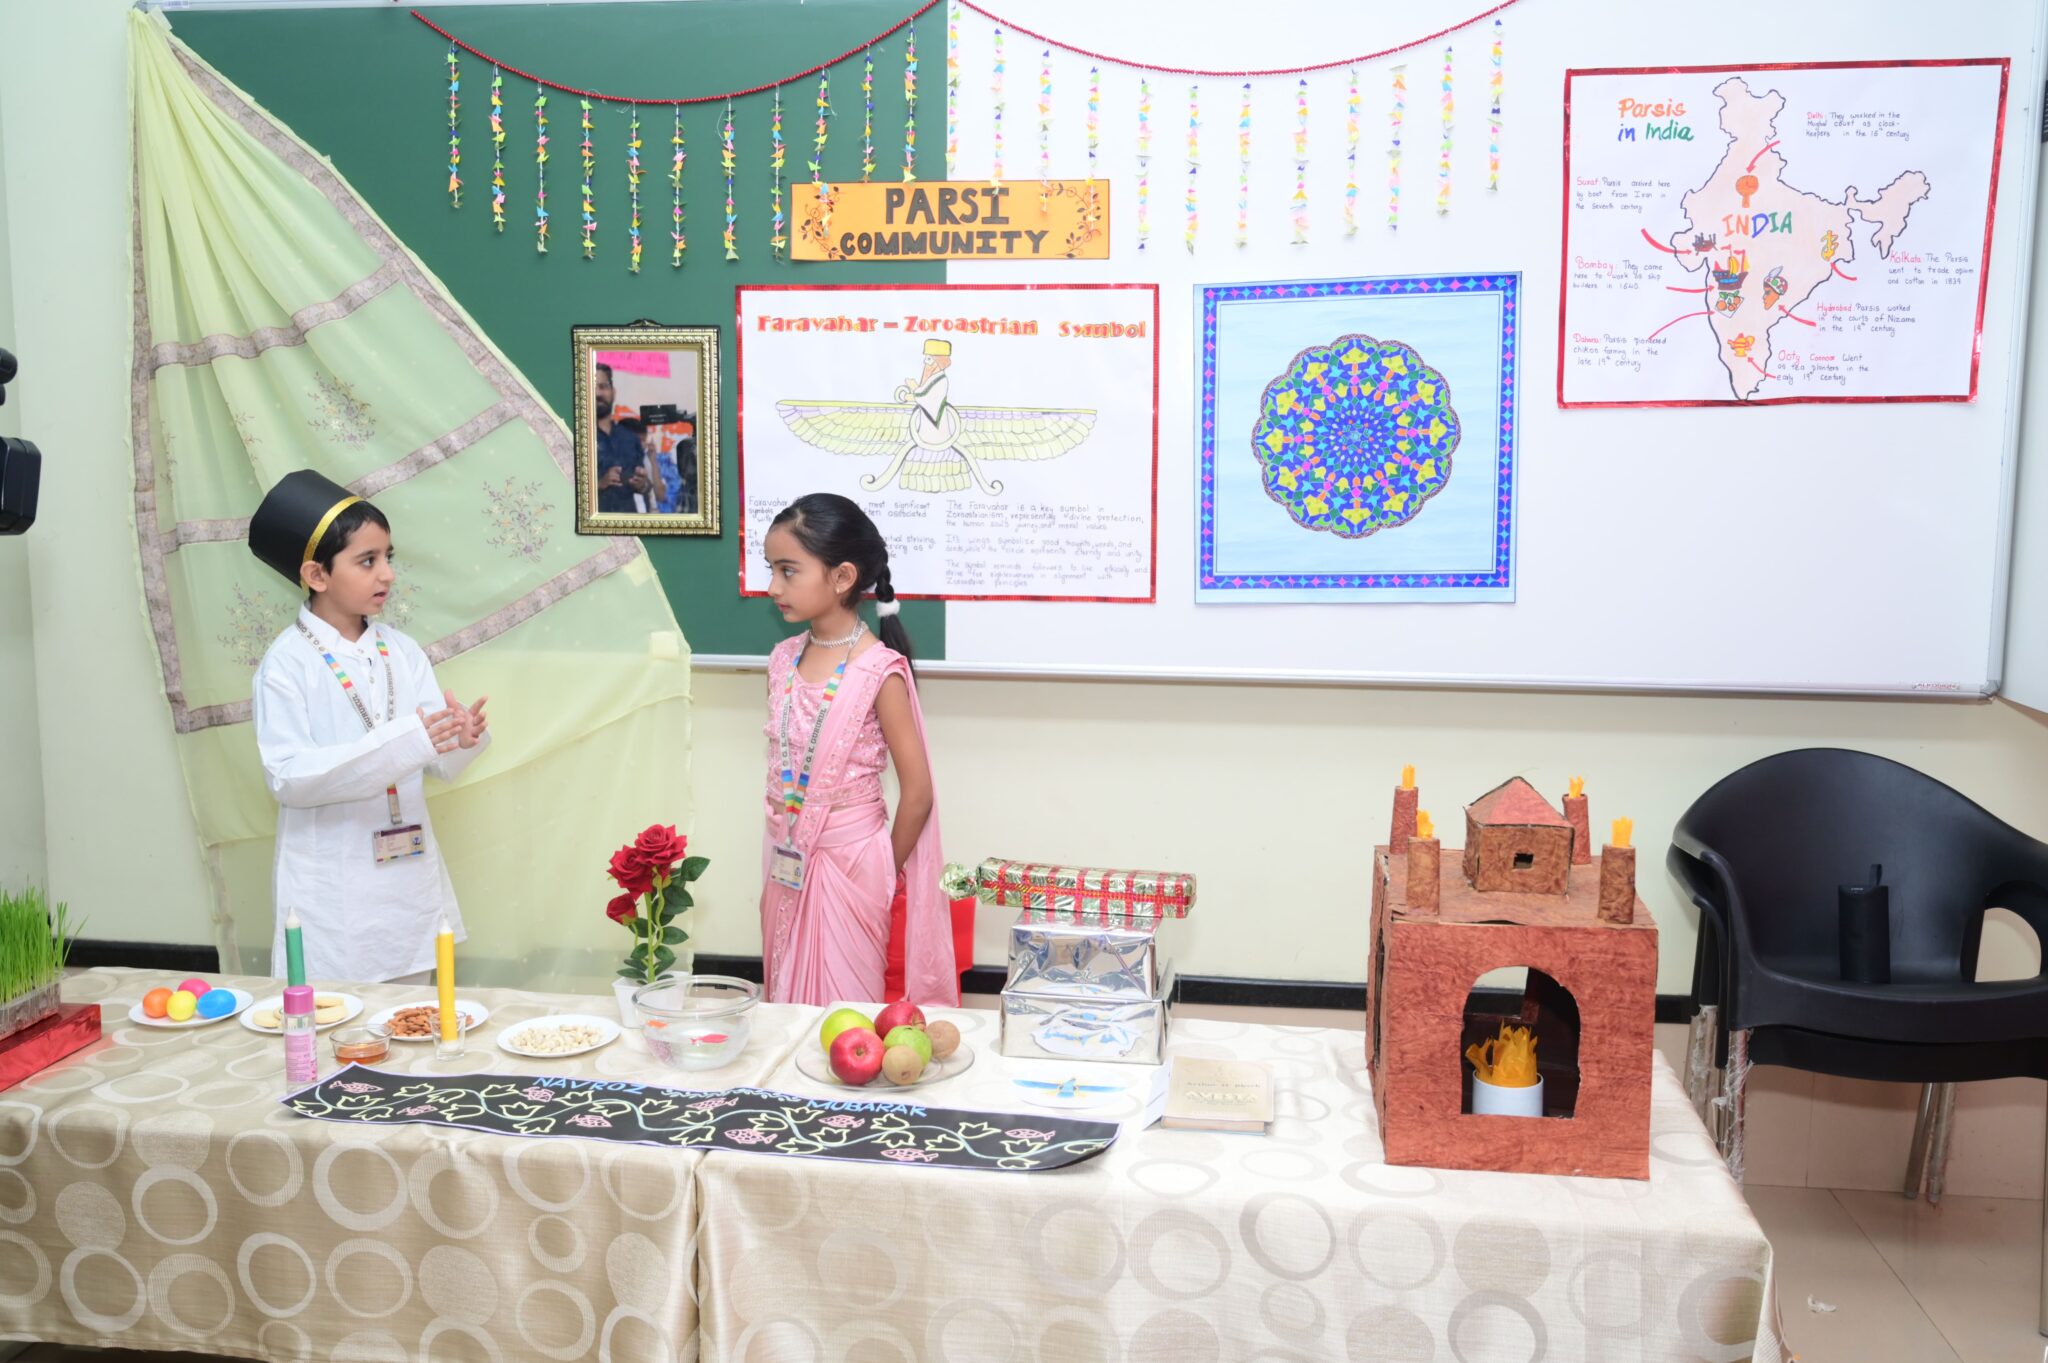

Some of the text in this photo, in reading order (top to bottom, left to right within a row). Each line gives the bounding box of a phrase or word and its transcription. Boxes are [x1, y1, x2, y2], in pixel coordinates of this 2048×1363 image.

[1617, 97, 1687, 118] Parsis
[1829, 111, 1845, 122] They
[1850, 111, 1876, 119] worked
[1888, 111, 1901, 119] the
[1833, 120, 1854, 128] court
[1617, 119, 1695, 142] in India
[1855, 129, 1867, 137] the
[1886, 129, 1910, 142] century
[1658, 179, 1671, 188] here
[1576, 190, 1584, 201] by
[1588, 190, 1602, 198] boat
[1611, 189, 1628, 198] from
[1634, 190, 1652, 198] Iran
[885, 187, 1010, 225] PARSI
[1576, 202, 1585, 210] the
[1620, 203, 1643, 214] century
[1722, 211, 1793, 240] INDIA
[839, 230, 1050, 256] COMMUNITY
[1925, 252, 1941, 263] The
[1944, 251, 1969, 263] Parsis
[1595, 272, 1603, 280] to
[1888, 266, 1904, 274] went
[1914, 266, 1922, 274] to
[1928, 266, 1949, 274] trade
[1888, 277, 1899, 285] and
[1855, 302, 1880, 312] Parsis
[1886, 304, 1912, 312] worked
[1818, 314, 1826, 322] in
[1832, 314, 1843, 322] the
[1848, 313, 1868, 323] courts
[1874, 312, 1886, 322] of
[757, 314, 879, 334] Faravahar
[903, 315, 1040, 337] Zoroastrian
[1058, 320, 1148, 339] Symbol
[1832, 324, 1843, 332] the
[1870, 324, 1896, 338] century
[1602, 333, 1628, 344] Parsis
[1632, 347, 1641, 355] in
[1646, 346, 1660, 356] the
[1577, 356, 1592, 366] late
[1615, 357, 1642, 373] century
[1858, 363, 1870, 372] the
[1776, 373, 1794, 386] early
[1820, 372, 1846, 386] century
[946, 499, 962, 510] The
[968, 501, 1009, 511] Faravahar
[1017, 503, 1025, 511] is
[1040, 503, 1054, 515] key
[810, 708, 828, 745] GURUKUL
[532, 1076, 648, 1095] NAVROZ
[806, 1099, 928, 1118] MUBARAK
